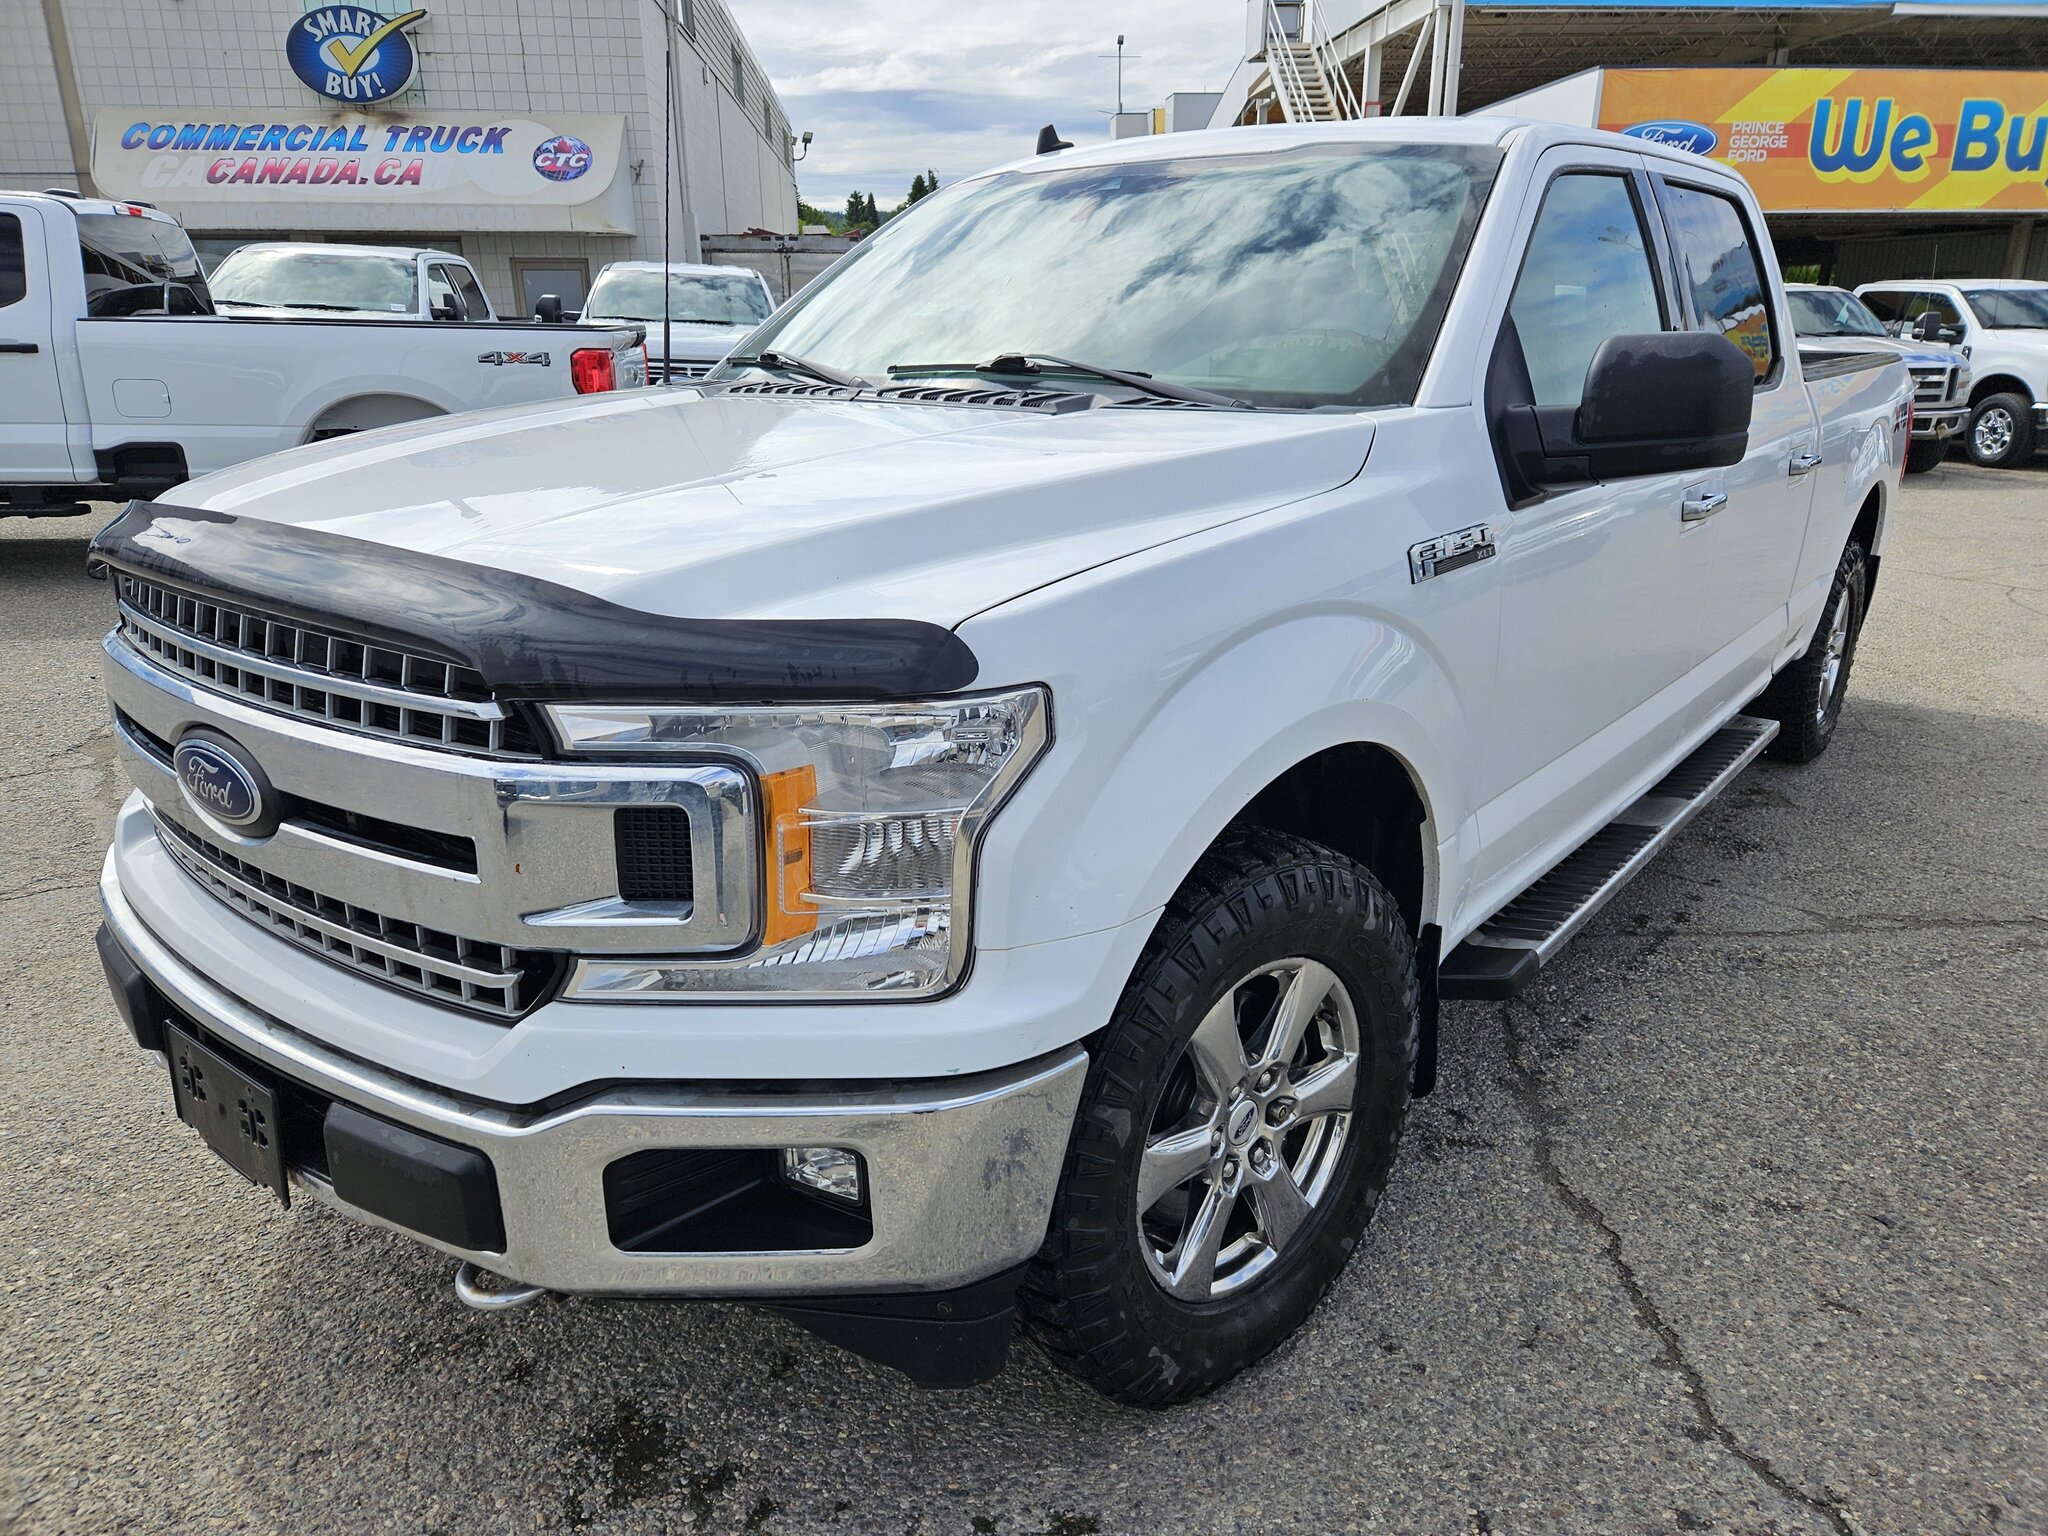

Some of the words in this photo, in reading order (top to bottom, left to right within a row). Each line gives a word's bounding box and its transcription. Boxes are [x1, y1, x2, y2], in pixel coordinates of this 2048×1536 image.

[303, 9, 387, 43] SMART
[325, 71, 387, 99] BUY!
[121, 122, 369, 152] COMMERCIAL
[383, 125, 513, 154] TRUCK
[1729, 135, 1790, 149] GEORGE
[1731, 121, 1785, 135] PRINCE
[1727, 149, 1768, 163] FORD
[1810, 98, 1932, 173] We
[1951, 99, 2048, 188] Bu
[206, 156, 424, 186] CANADA.CA
[535, 152, 589, 168] CTC
[186, 755, 233, 810] Ford
